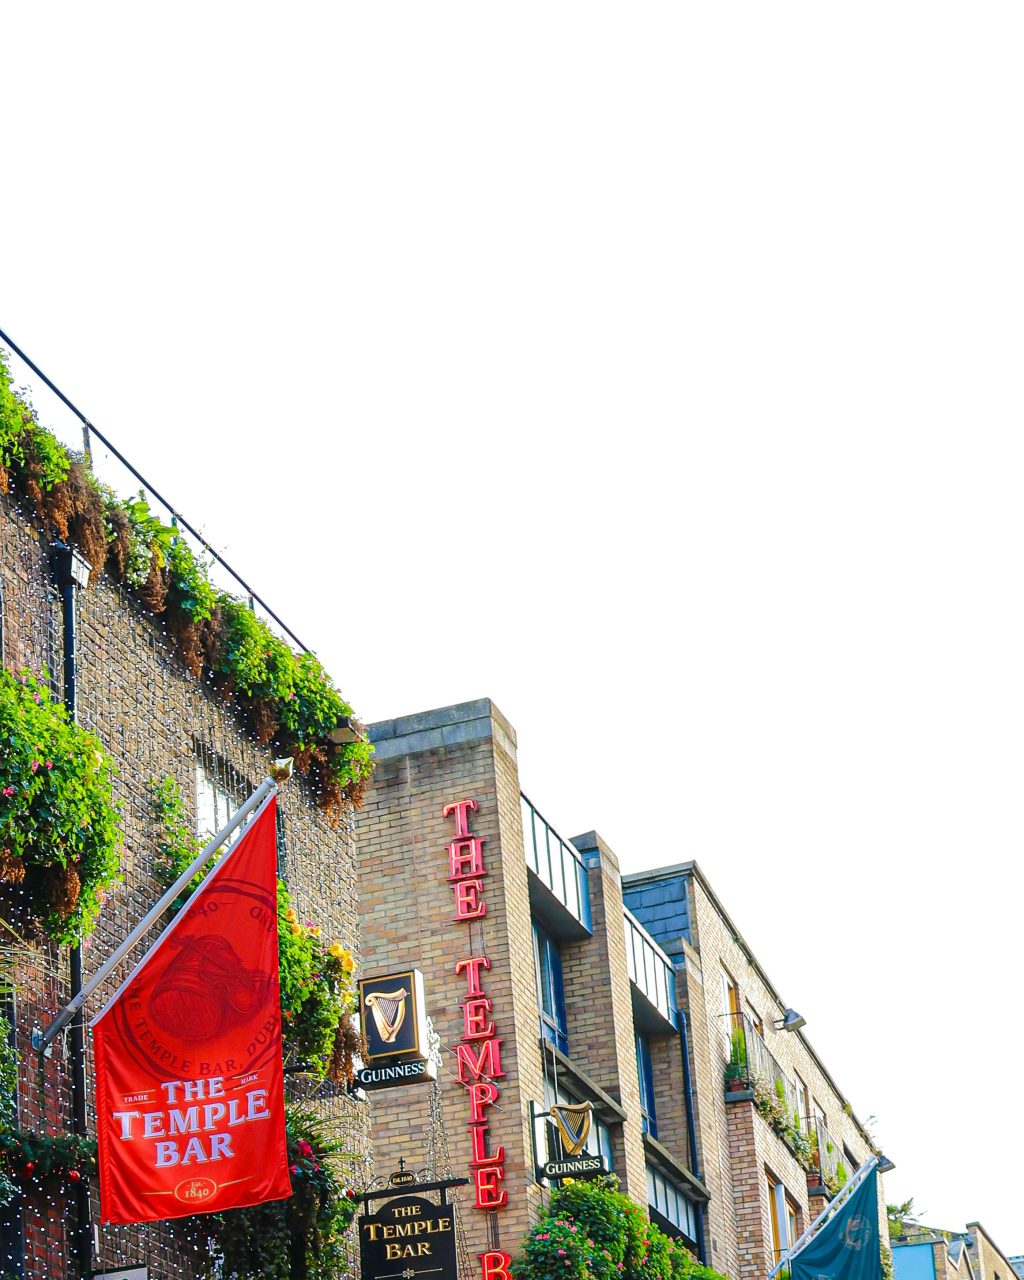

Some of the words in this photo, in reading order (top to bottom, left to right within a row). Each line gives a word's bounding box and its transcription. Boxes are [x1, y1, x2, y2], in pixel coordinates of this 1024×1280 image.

[443, 799, 487, 922] THE
[134, 1017, 192, 1073] TEMPLE
[240, 1073, 259, 1084] MARK
[360, 1062, 426, 1084] GUINNESS
[455, 956, 508, 1210] TEMPLE
[124, 1094, 149, 1103] TRADE
[161, 1076, 226, 1104] THE
[112, 1089, 270, 1140] TEMPLE
[154, 1132, 235, 1168] BAR
[546, 1158, 601, 1176] GUINNESS
[184, 1187, 209, 1198] 1840
[391, 1205, 422, 1218] THE
[364, 1218, 451, 1242] TEMPLE
[385, 1241, 433, 1260] BAR
